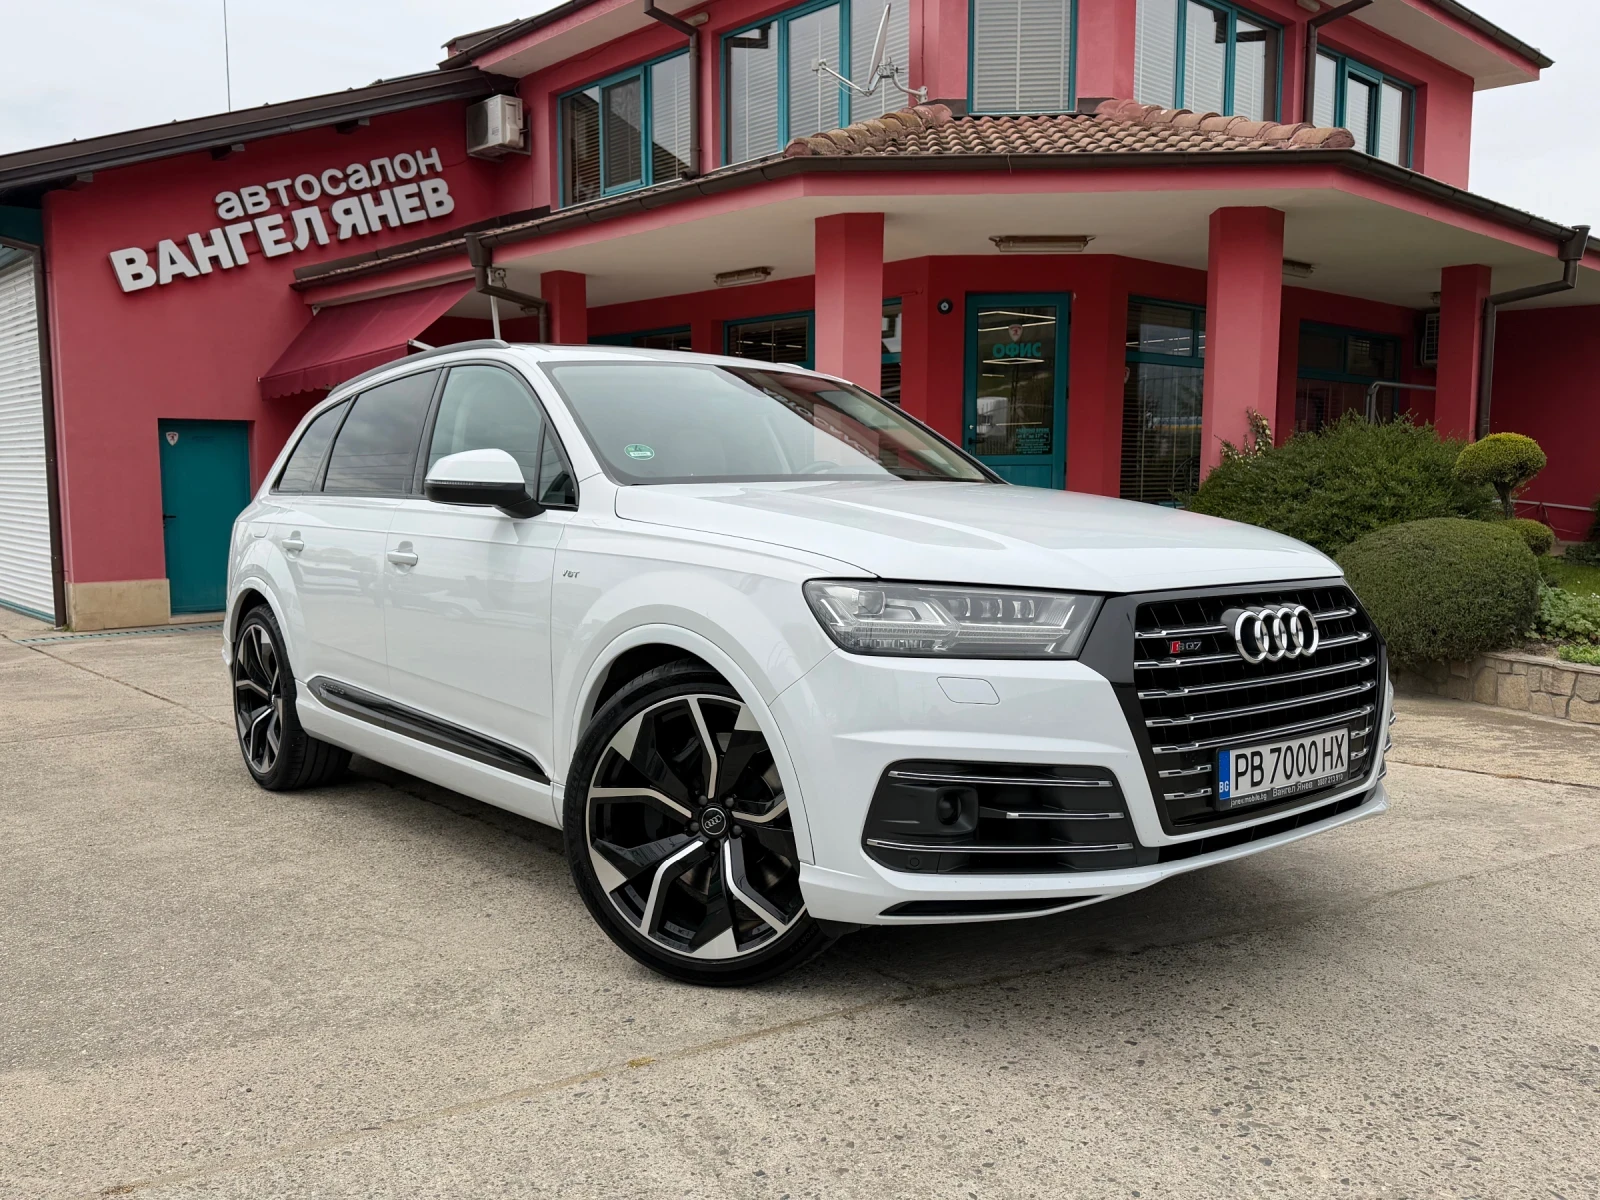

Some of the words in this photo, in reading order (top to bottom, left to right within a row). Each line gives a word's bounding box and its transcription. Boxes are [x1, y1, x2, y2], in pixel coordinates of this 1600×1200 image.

[214, 147, 443, 220] автосалон
[108, 205, 330, 292] ВАНГЕЛ
[330, 177, 455, 241] ЯНЕВ
[992, 341, 1042, 358] ОФИС
[1234, 750, 1265, 791] PB
[1270, 740, 1318, 784] 7000
[1322, 734, 1345, 772] HX
[1219, 781, 1230, 793] BG
[1272, 786, 1296, 797] Вангел
[1296, 782, 1313, 793] Янев
